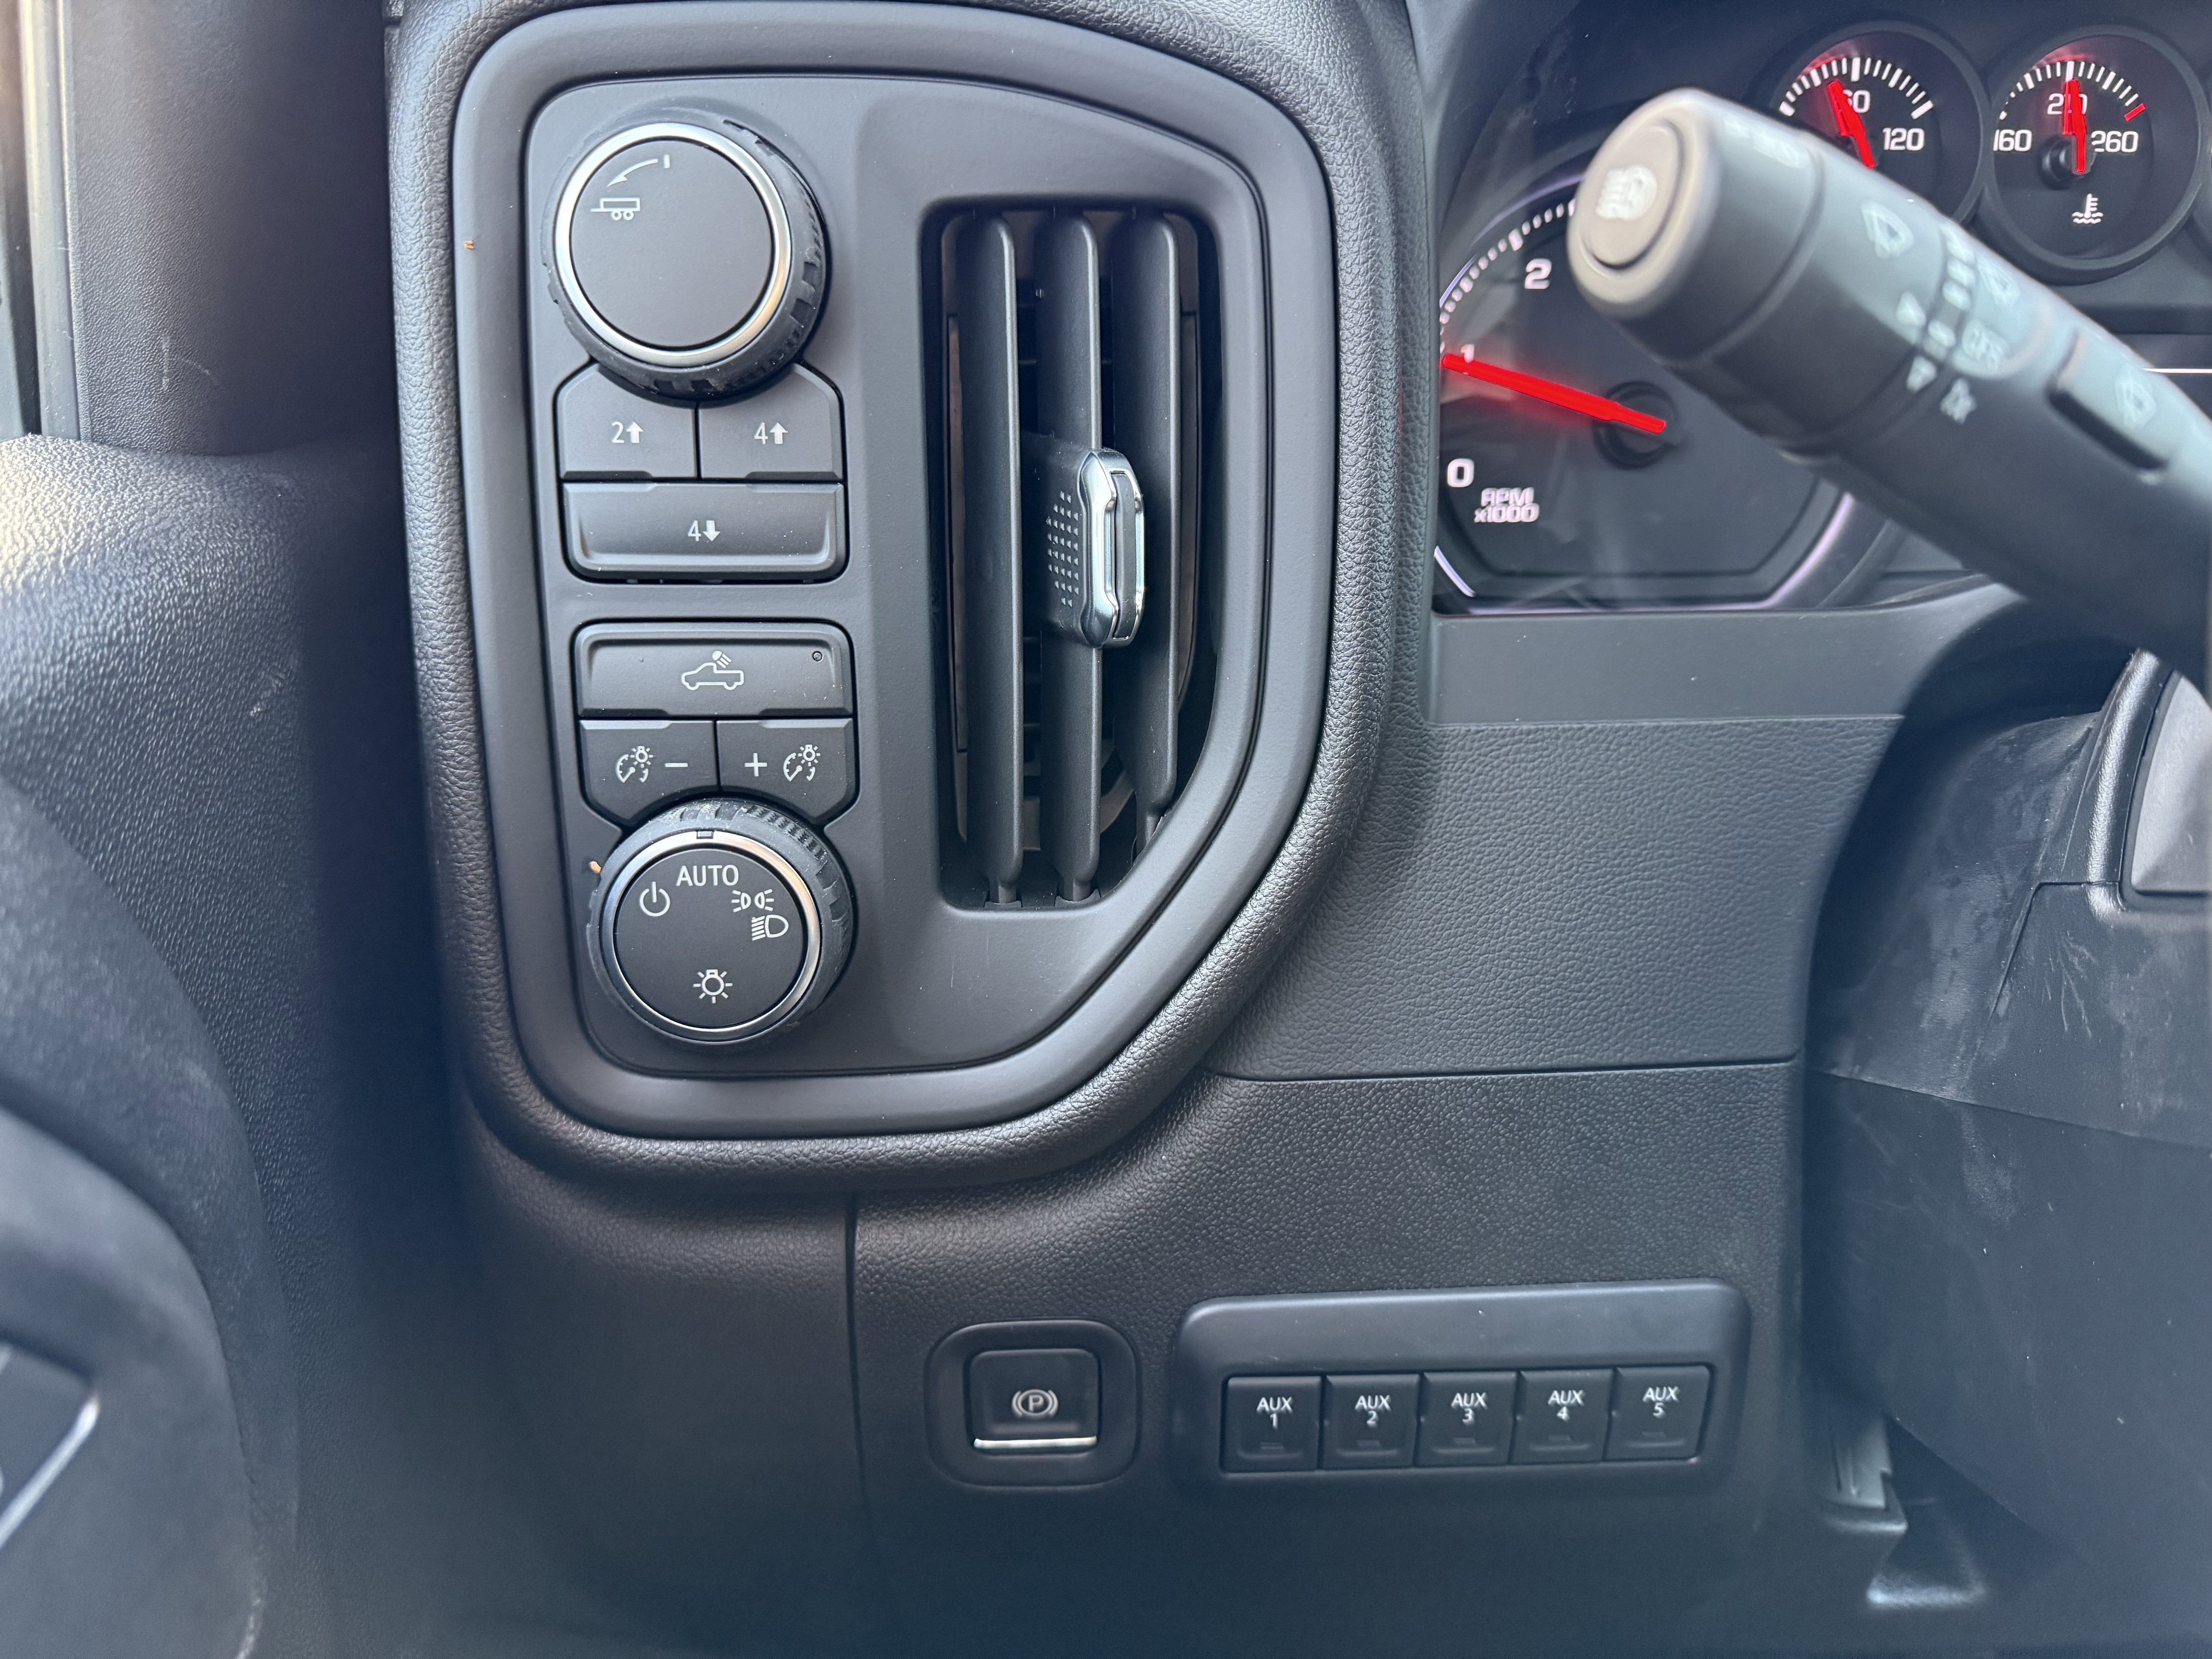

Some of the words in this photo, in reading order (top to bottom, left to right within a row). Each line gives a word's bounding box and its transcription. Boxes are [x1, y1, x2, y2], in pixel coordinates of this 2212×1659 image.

[1882, 127, 1925, 151] 120
[1993, 129, 2032, 151] 160
[2091, 130, 2138, 153] 260
[1525, 258, 1552, 289] 2
[1447, 458, 1475, 487] 0
[1481, 487, 1534, 507] RPM
[676, 864, 739, 887] AUTO
[1451, 1392, 1487, 1410] AUX
[1548, 1390, 1584, 1406] AUX
[1643, 1386, 1679, 1402] AUX
[1257, 1397, 1293, 1414] AUX
[1355, 1395, 1391, 1412] AUX
[1653, 1402, 1665, 1418] 5
[1270, 1413, 1278, 1429] 1
[1367, 1411, 1378, 1427] 2
[1462, 1408, 1474, 1425] 3
[1557, 1406, 1569, 1421] 4
